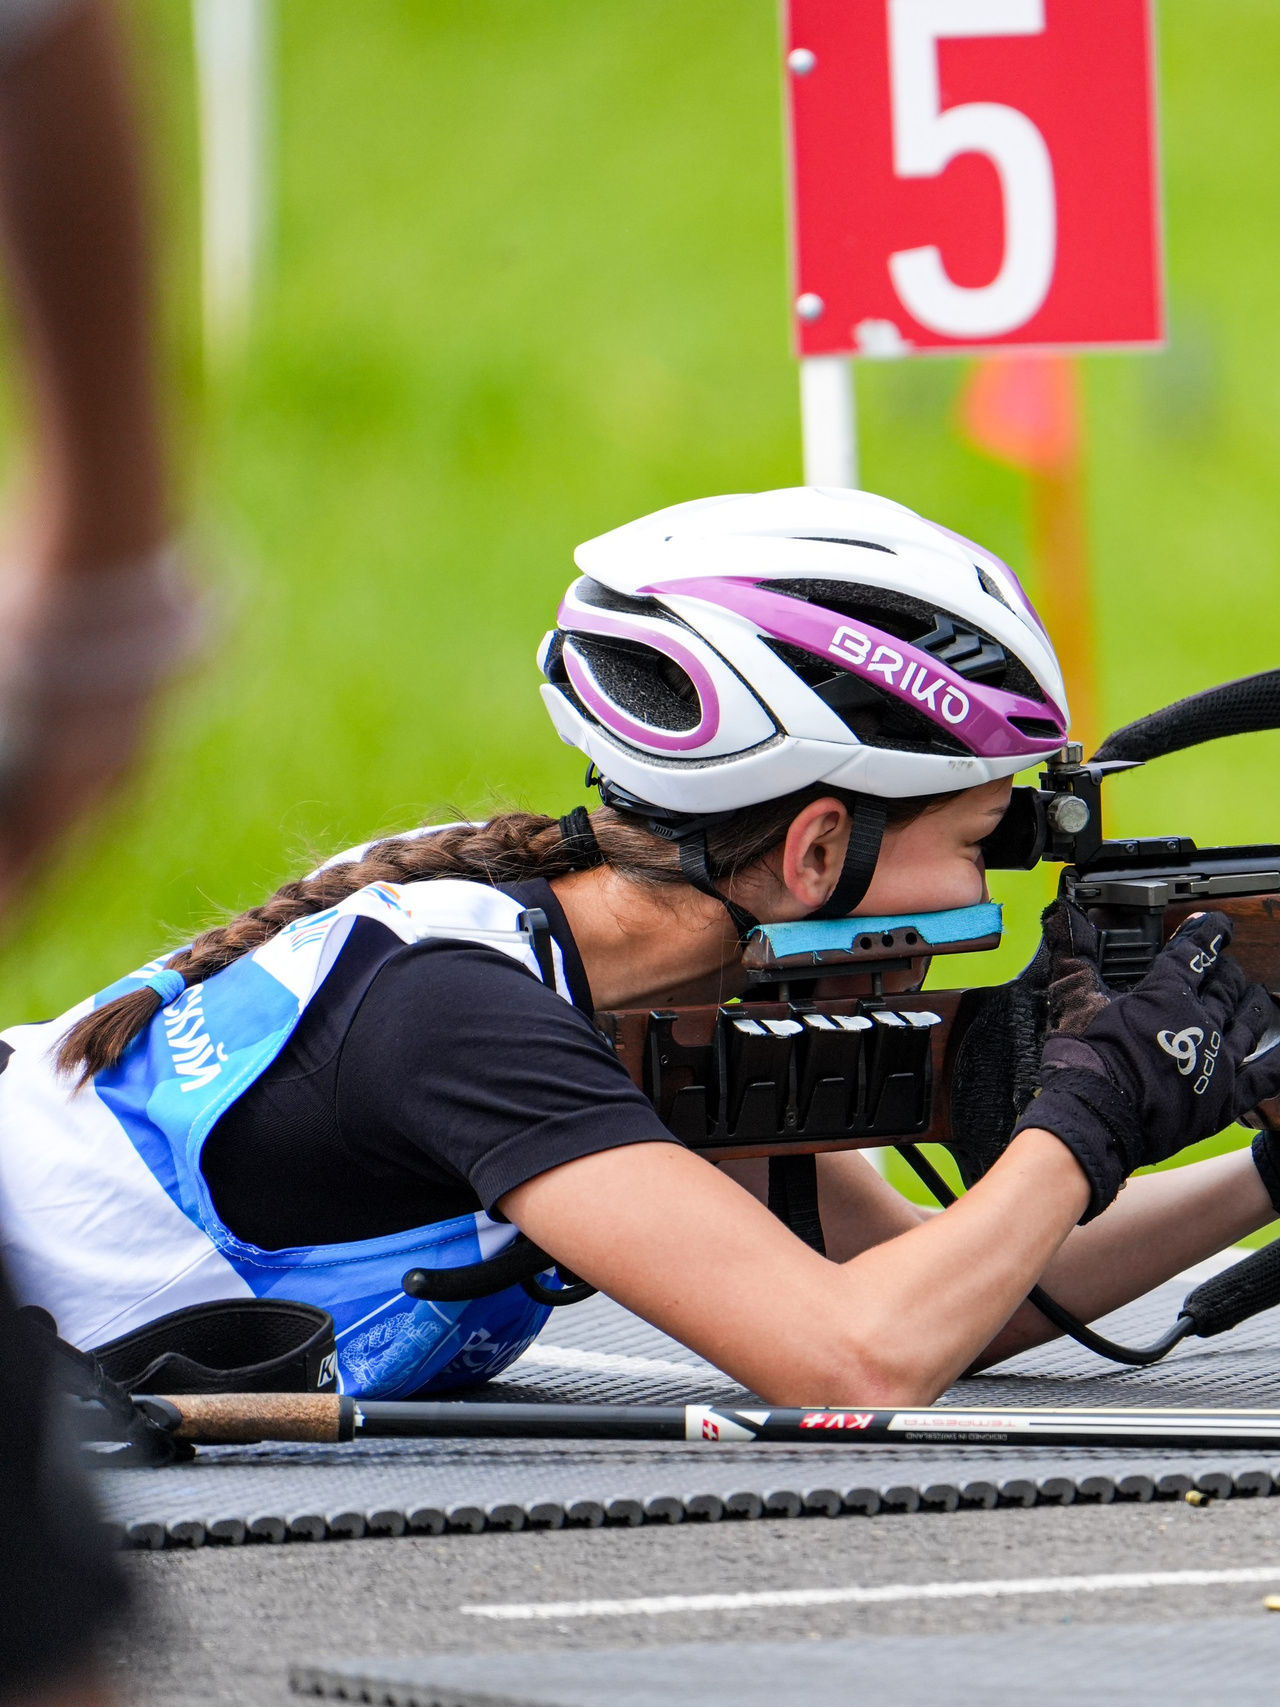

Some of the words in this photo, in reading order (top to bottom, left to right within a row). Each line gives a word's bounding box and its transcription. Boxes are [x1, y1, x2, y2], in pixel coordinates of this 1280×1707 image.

[886, 0, 1057, 339] 5
[828, 625, 970, 725] BRIKO
[162, 983, 229, 1093] СКИЙ
[1193, 1030, 1221, 1095] odlo
